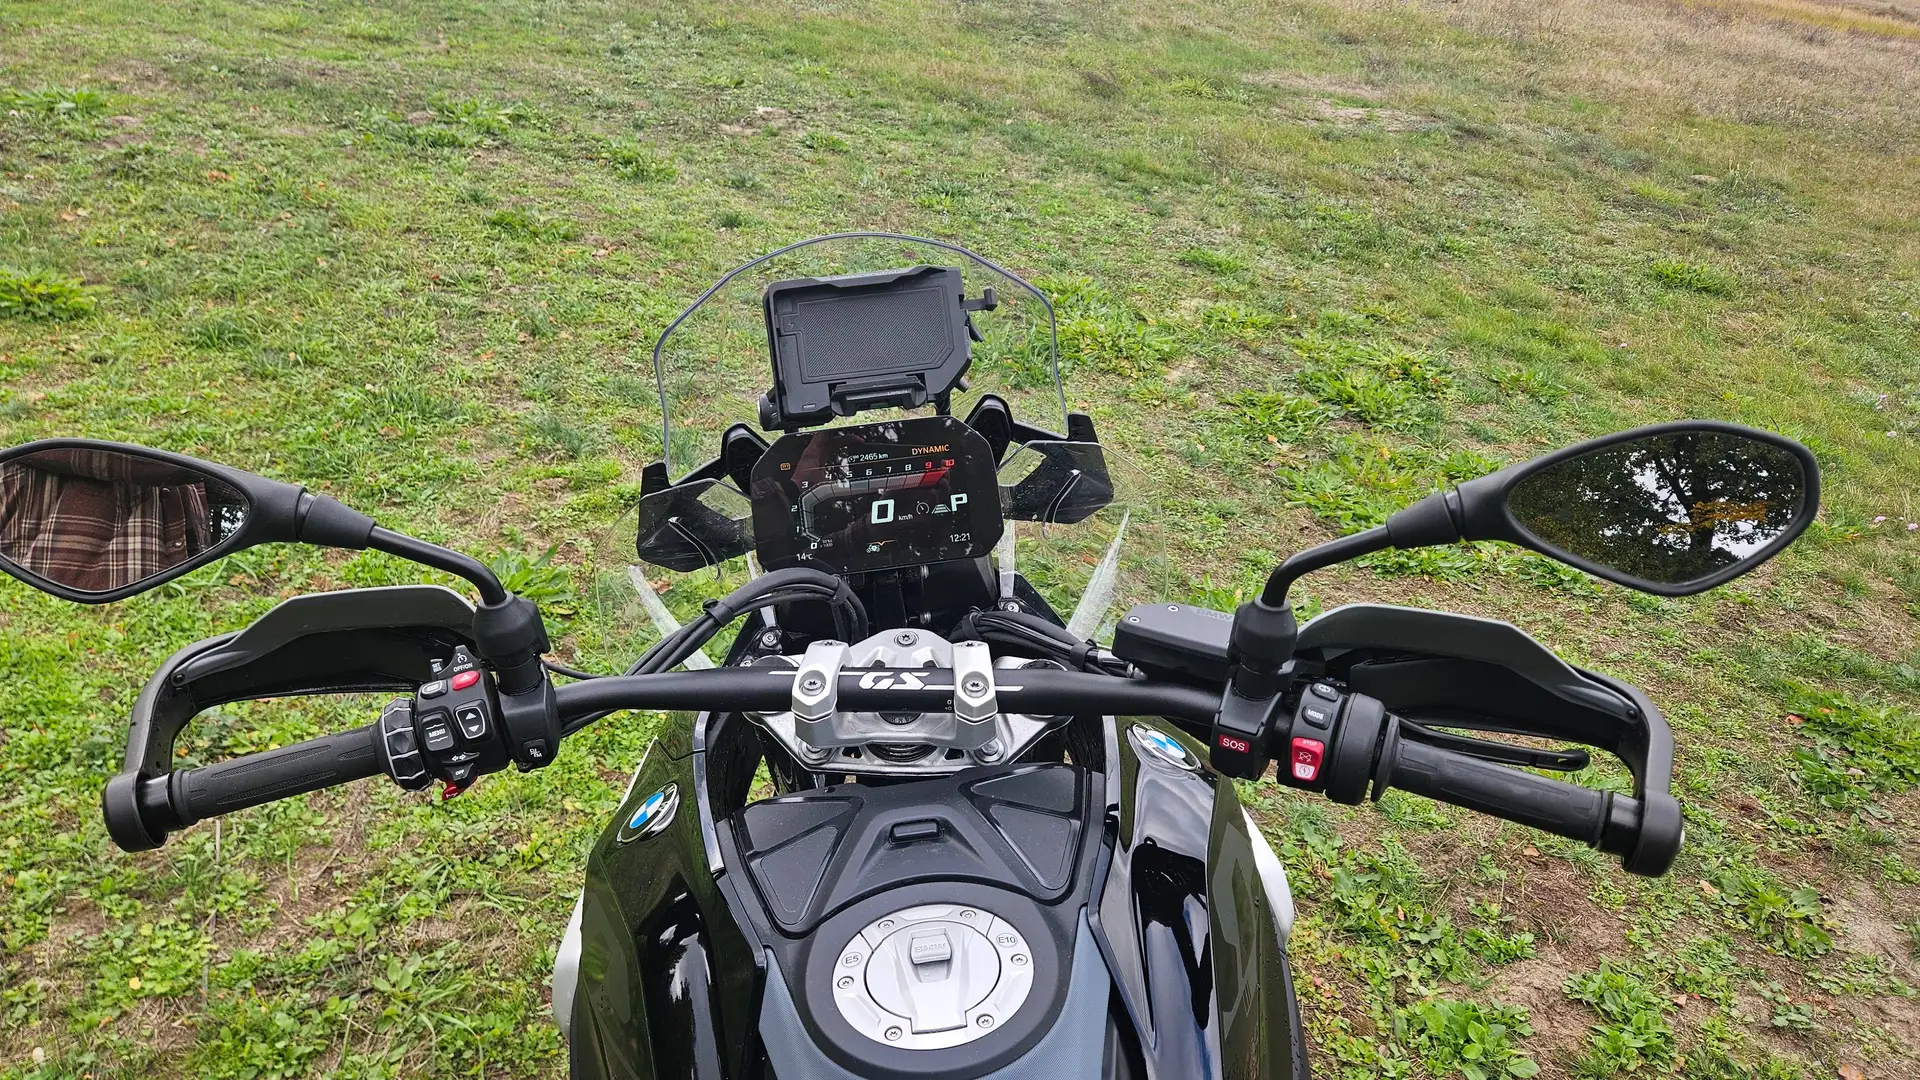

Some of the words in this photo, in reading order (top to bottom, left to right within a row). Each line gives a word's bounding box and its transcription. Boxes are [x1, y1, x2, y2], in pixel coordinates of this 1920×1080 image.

[911, 444, 950, 456] DYNAMIC
[859, 452, 878, 462] 2465
[846, 470, 853, 478] 5
[866, 468, 873, 476] 6
[945, 458, 955, 466] 10
[801, 481, 808, 489] 3
[950, 492, 968, 512] P
[791, 504, 798, 512] 2
[870, 498, 895, 524] 0
[898, 512, 914, 521] km/h
[950, 532, 971, 542] 12:21
[810, 542, 818, 550] 0
[1196, 608, 1233, 620] BMW
[859, 672, 930, 690] GS
[1308, 708, 1324, 720] MODE
[428, 728, 446, 738] MENU
[1222, 738, 1245, 751] SOS
[998, 936, 1016, 944] E10
[844, 954, 860, 964] E5
